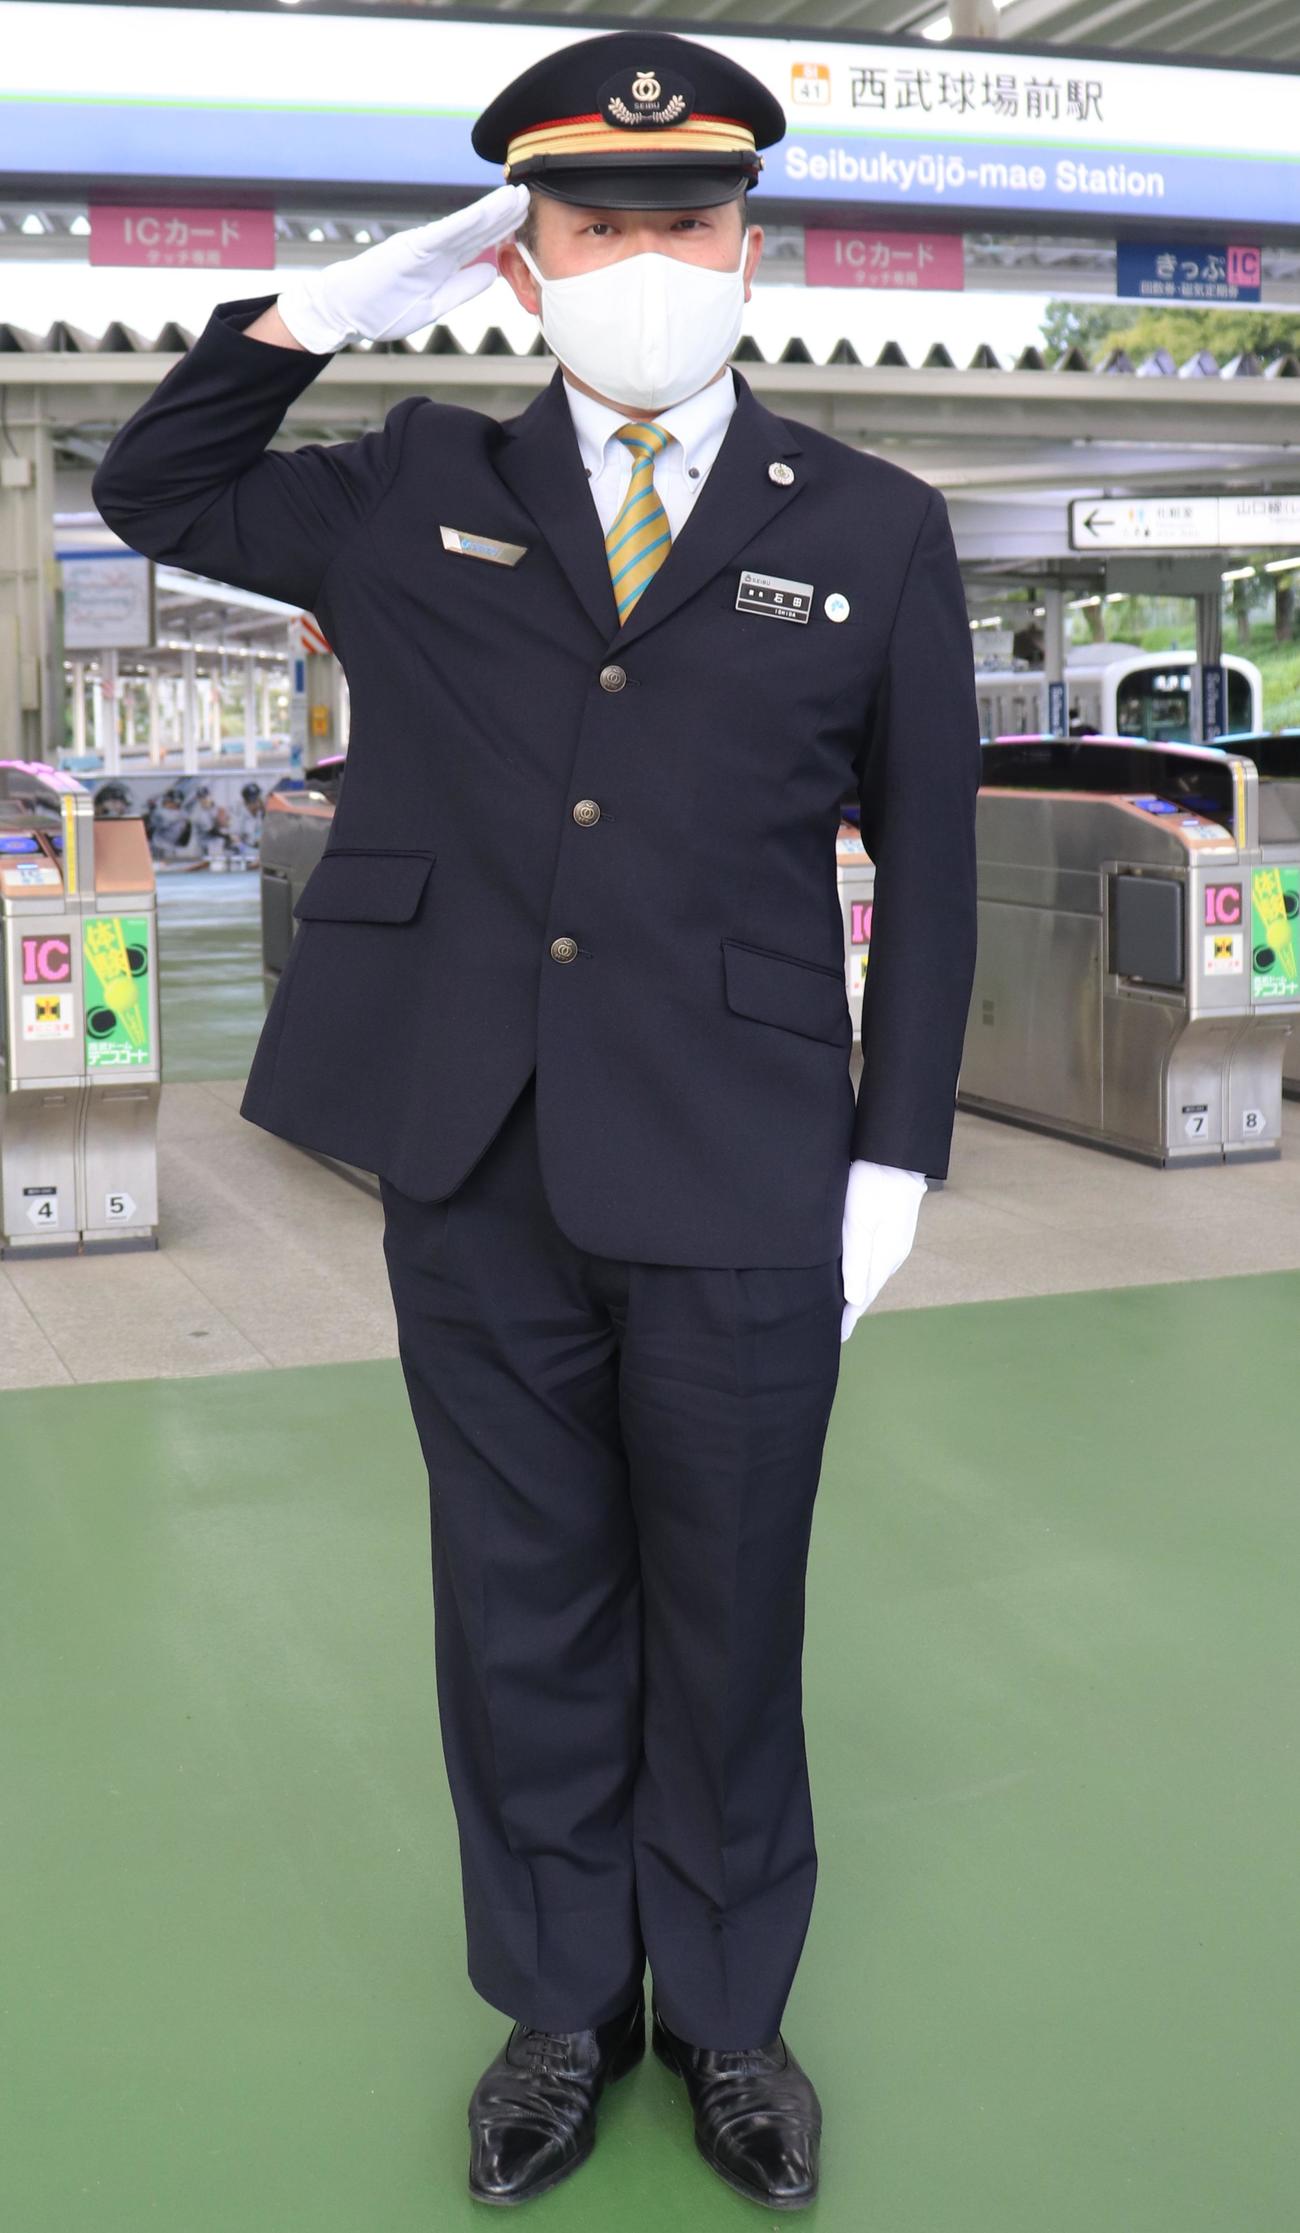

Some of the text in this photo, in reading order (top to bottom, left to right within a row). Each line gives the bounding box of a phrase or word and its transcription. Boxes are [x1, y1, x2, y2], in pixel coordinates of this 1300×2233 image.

[800, 82, 821, 100] 41
[848, 65, 1104, 122] 西武球場前駅
[785, 146, 1165, 198] Seibukyūjō-mae Station
[124, 216, 240, 247] ICカード
[834, 239, 935, 270] ICカード
[1232, 251, 1258, 275] IC
[1155, 252, 1226, 282] きっぷ
[773, 592, 802, 608] 石田
[1205, 886, 1240, 925] IC
[23, 939, 70, 983] IC
[88, 1049, 148, 1066] テニスコート
[1193, 1117, 1204, 1133] 7
[1246, 1112, 1257, 1128] 8
[38, 1201, 53, 1218] 4
[109, 1196, 125, 1214] 5
